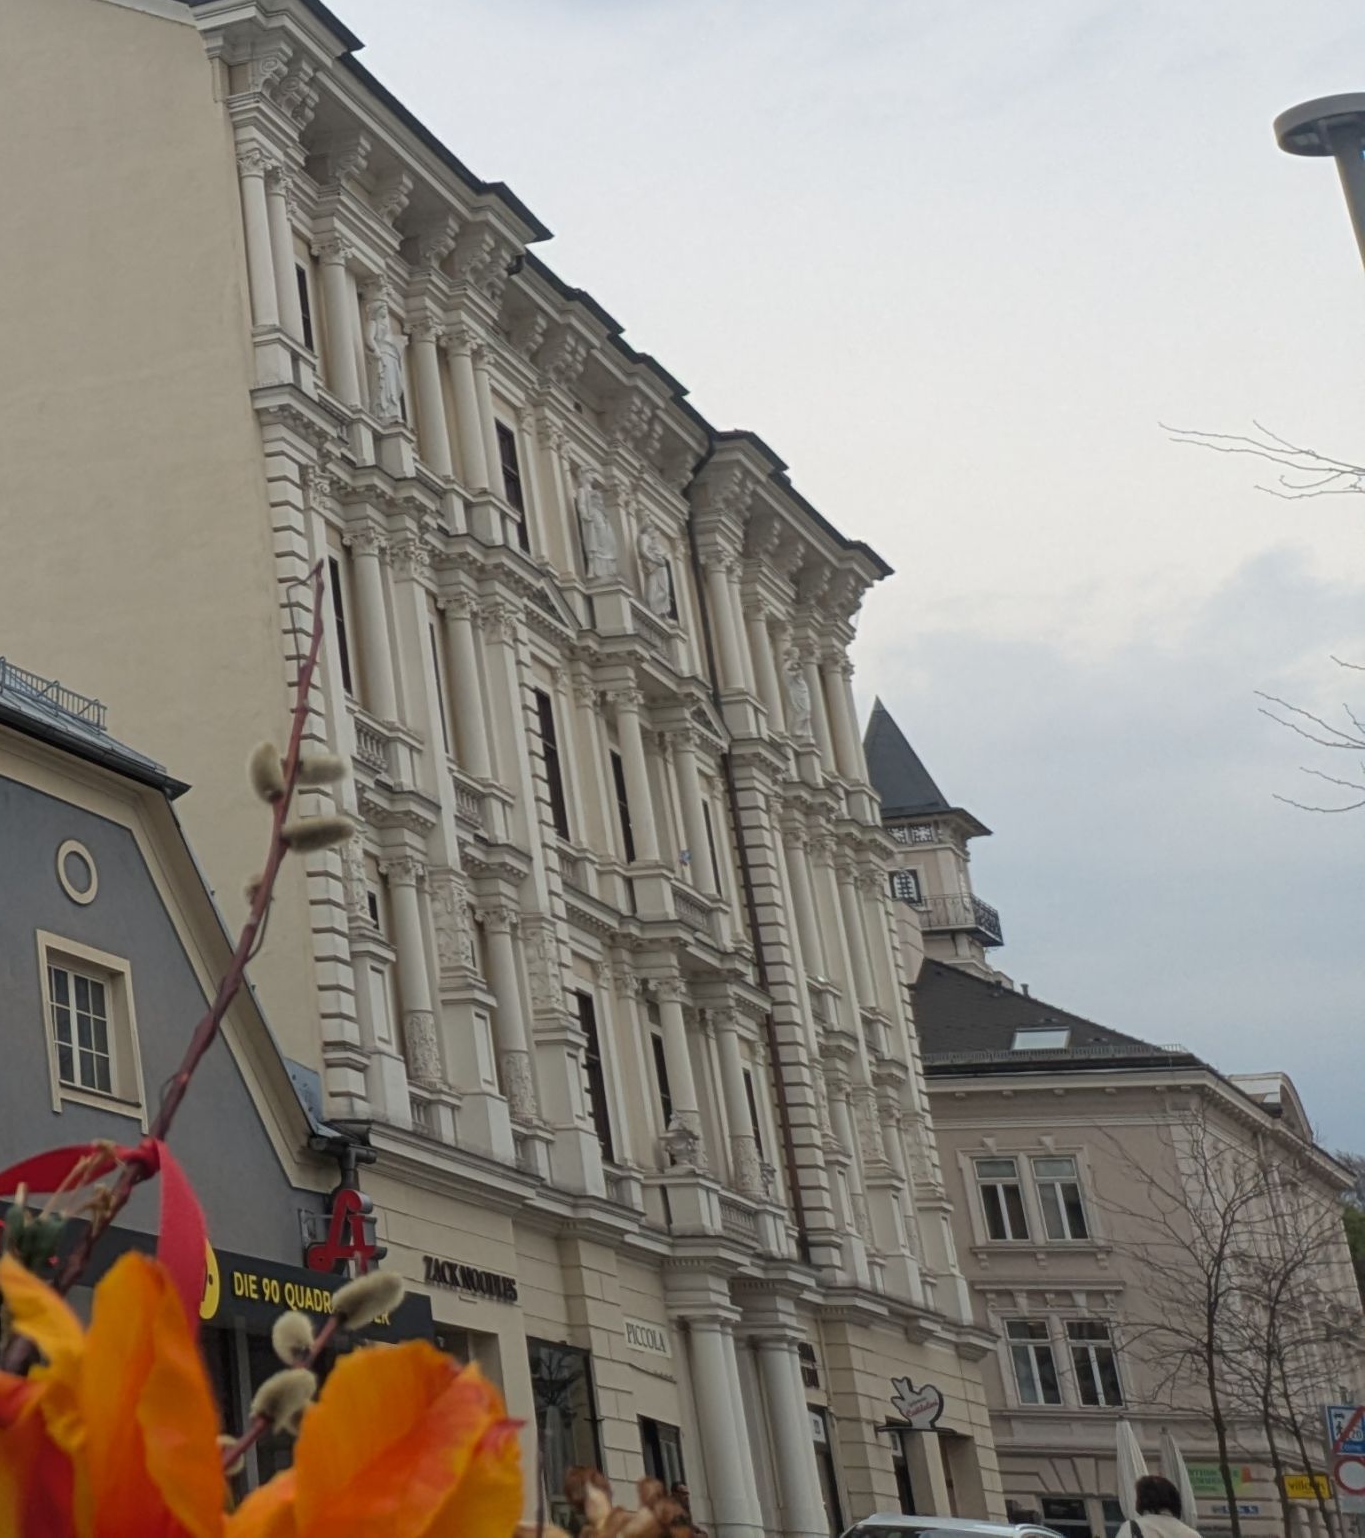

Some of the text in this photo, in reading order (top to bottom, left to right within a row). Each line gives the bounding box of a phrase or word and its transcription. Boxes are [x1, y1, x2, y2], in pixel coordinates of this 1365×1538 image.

[422, 1255, 460, 1286] ZACK
[233, 1271, 259, 1299] DIE
[262, 1280, 280, 1304] 90
[625, 1322, 666, 1353] PICCOLA
